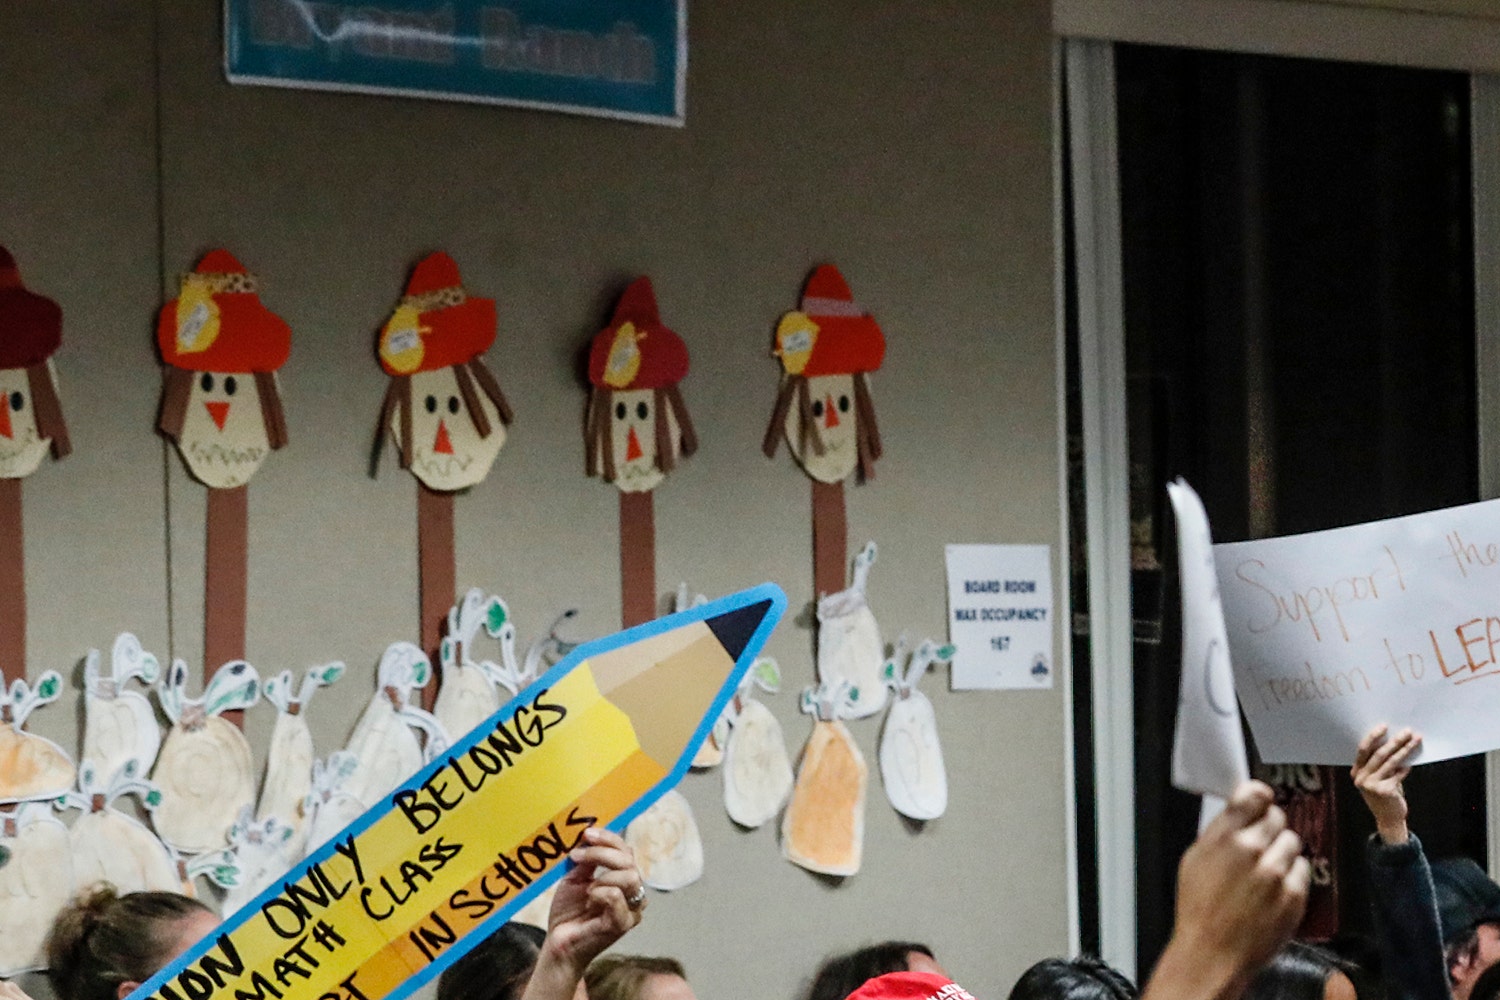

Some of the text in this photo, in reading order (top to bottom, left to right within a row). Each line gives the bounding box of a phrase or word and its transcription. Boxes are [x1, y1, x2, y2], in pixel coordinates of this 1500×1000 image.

[965, 580, 1036, 593] BOARD ROOM
[1236, 530, 1498, 643] Support the
[1384, 637, 1426, 685] to
[262, 833, 369, 940] ONLY
[394, 689, 568, 834] BELONGS
[361, 837, 463, 921] CLASS
[409, 917, 454, 962] IN
[451, 807, 598, 919] SCHOOLS
